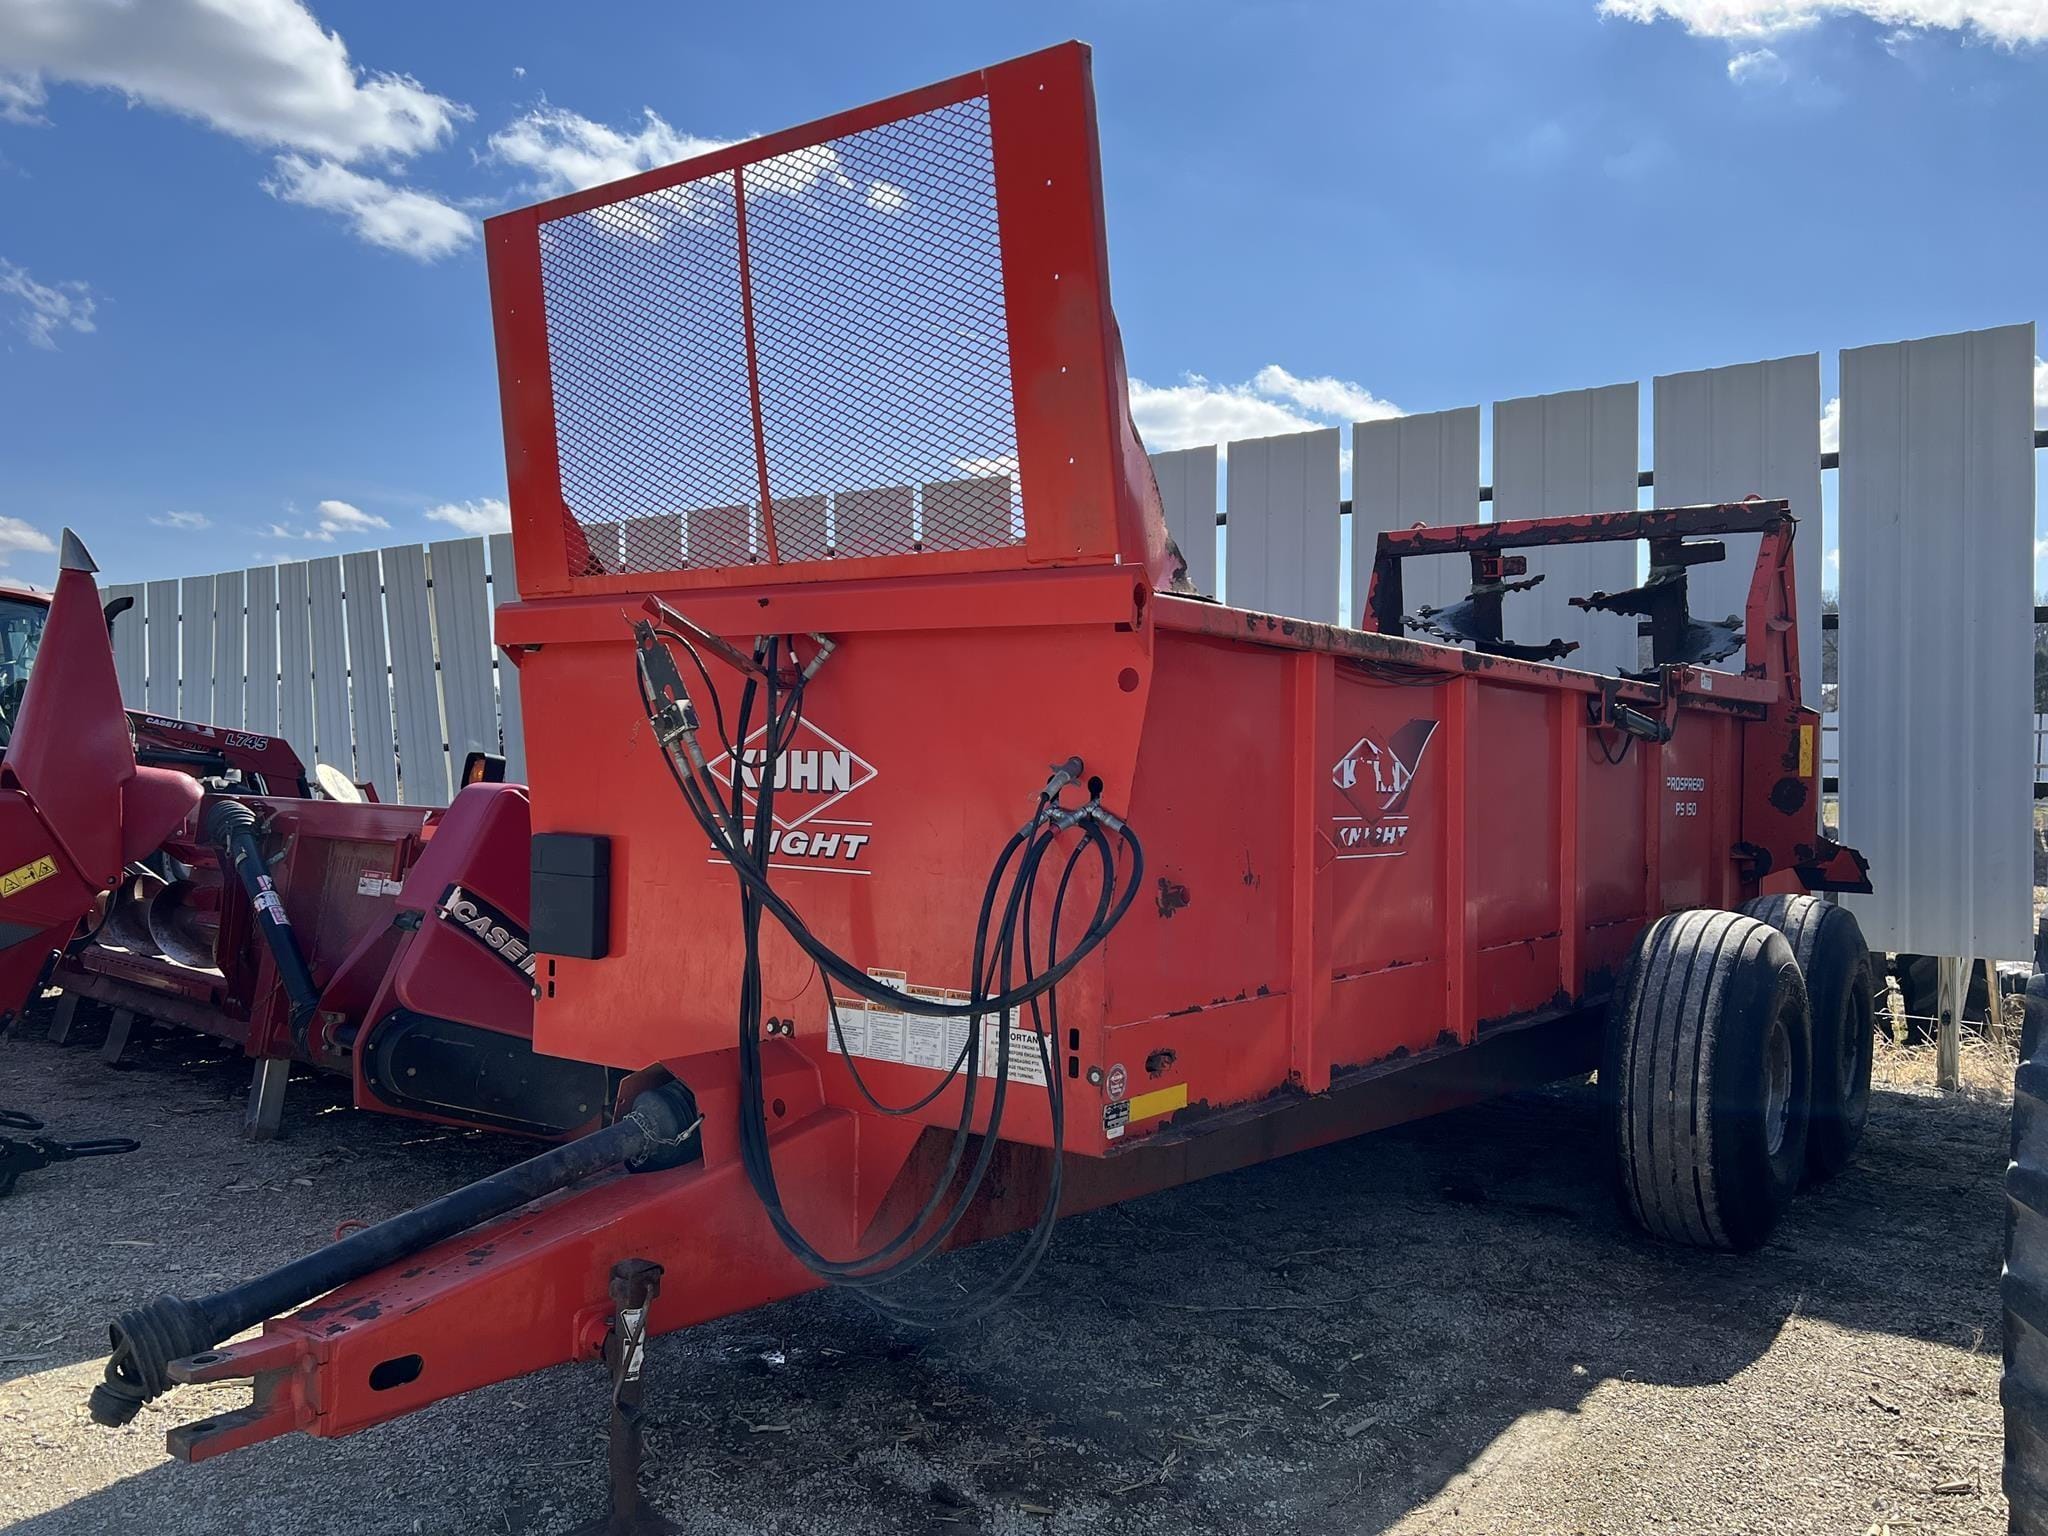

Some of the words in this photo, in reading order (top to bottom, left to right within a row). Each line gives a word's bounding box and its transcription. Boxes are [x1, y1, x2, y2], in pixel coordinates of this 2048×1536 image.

[225, 733, 268, 751] L745
[730, 749, 850, 792] KUHN
[1675, 802, 1685, 816] PS
